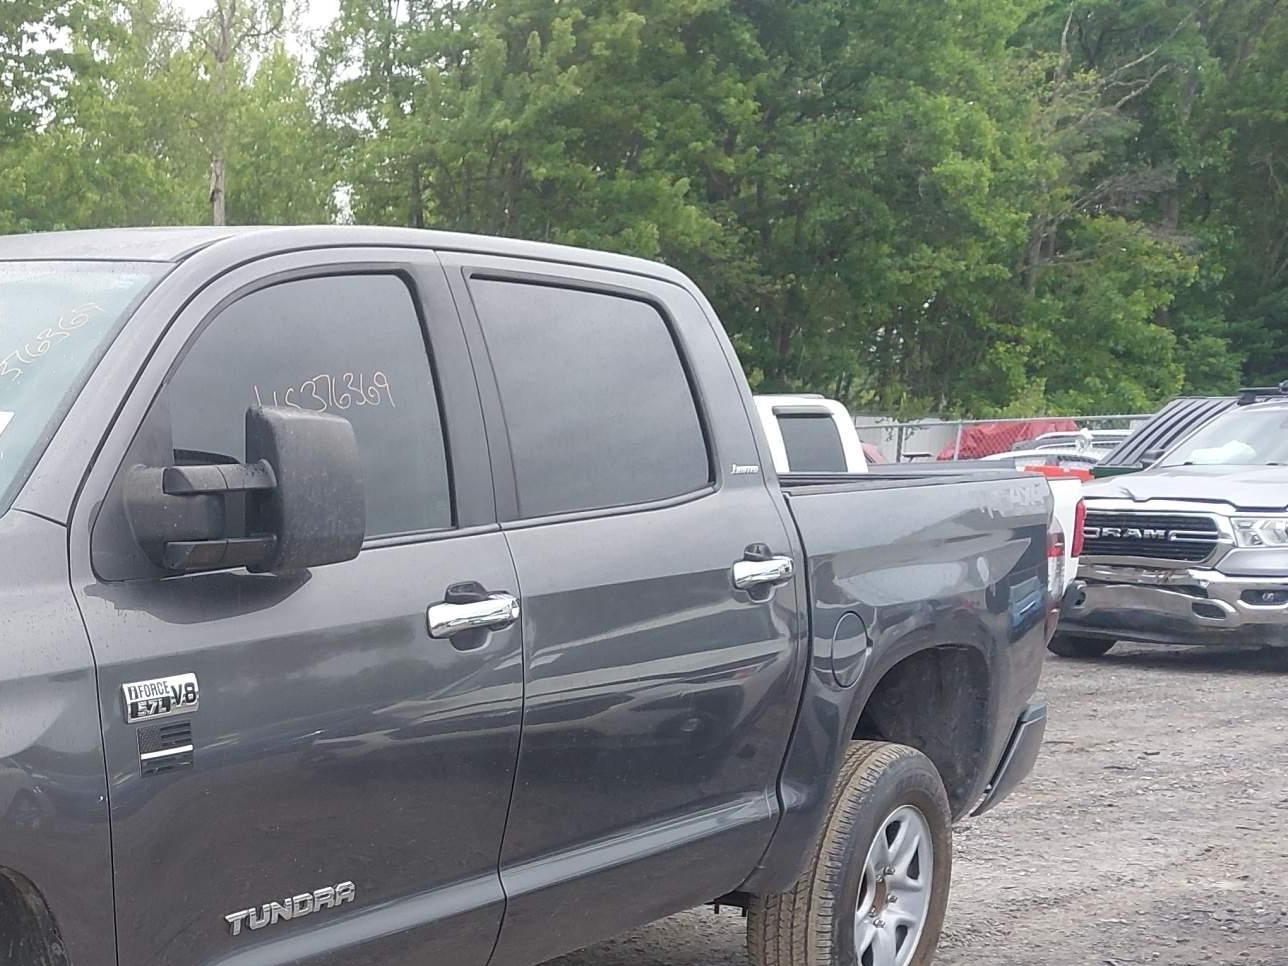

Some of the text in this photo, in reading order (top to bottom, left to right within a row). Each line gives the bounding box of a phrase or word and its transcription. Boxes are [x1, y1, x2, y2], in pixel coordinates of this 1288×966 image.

[1101, 527, 1166, 540] RAM
[170, 681, 198, 706] V8
[224, 880, 356, 937] TUNDRA
